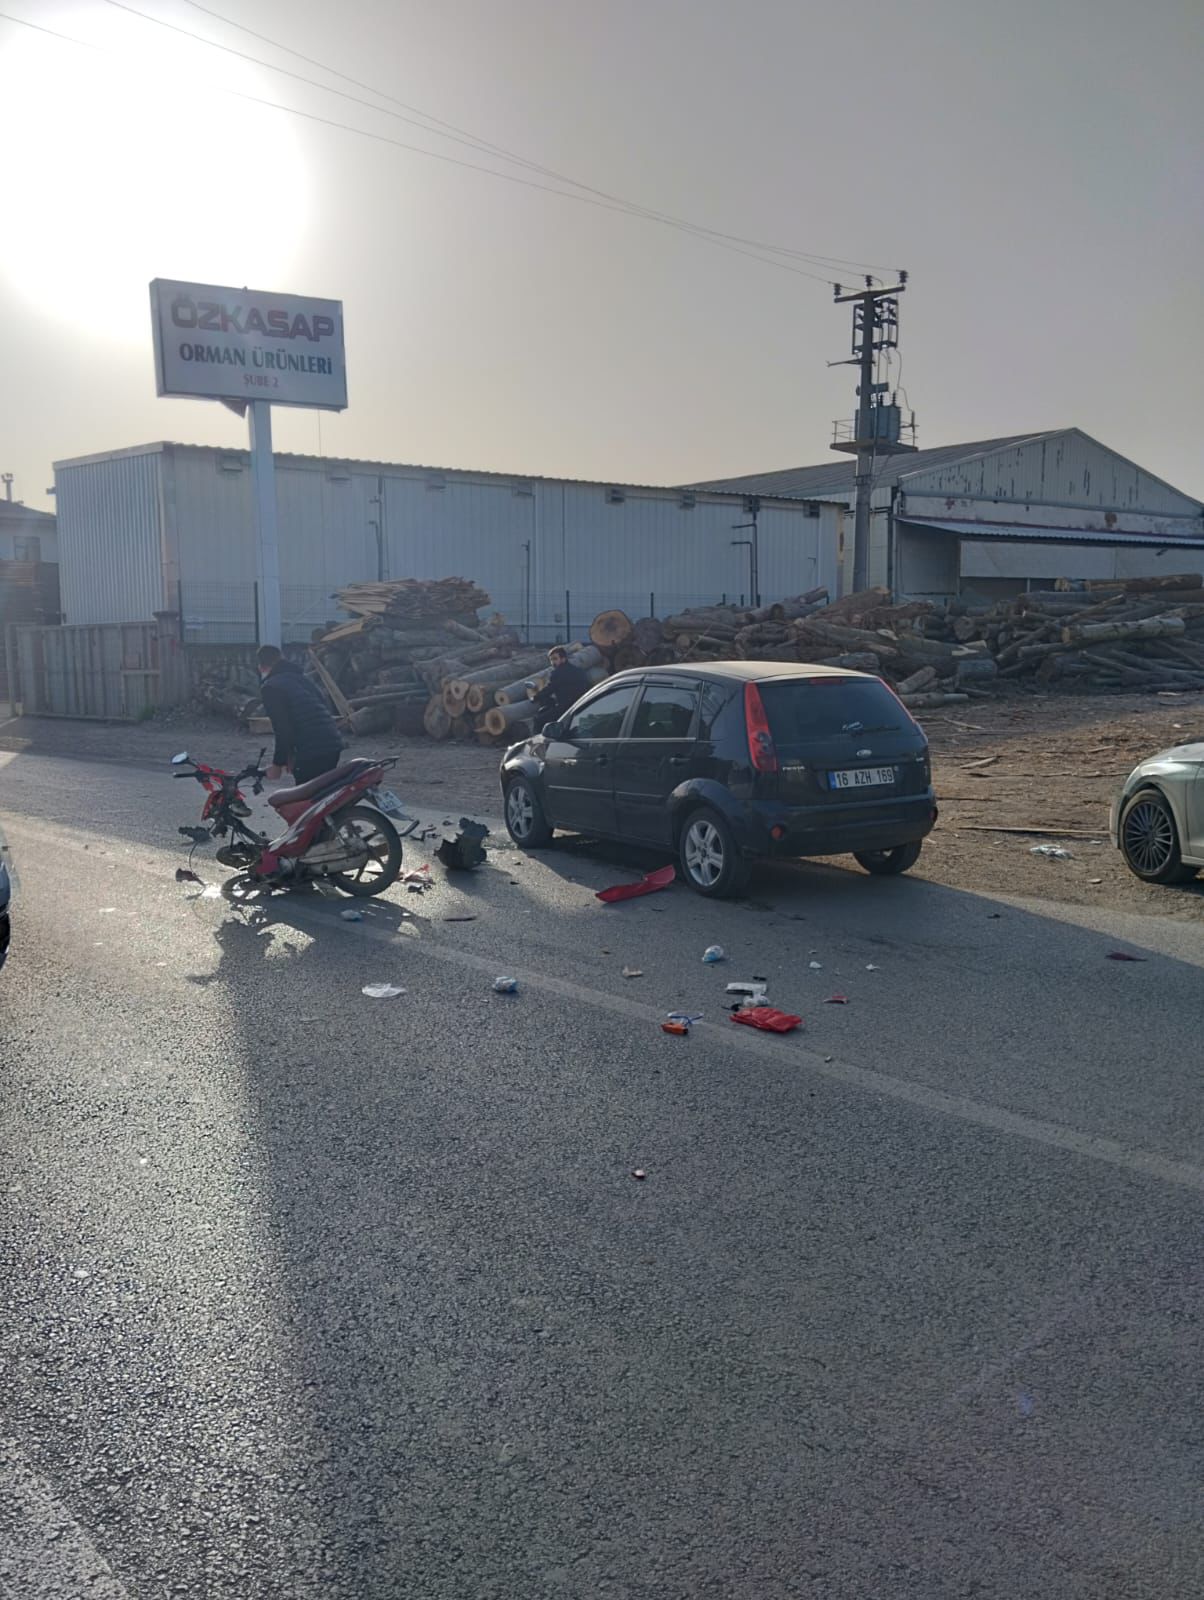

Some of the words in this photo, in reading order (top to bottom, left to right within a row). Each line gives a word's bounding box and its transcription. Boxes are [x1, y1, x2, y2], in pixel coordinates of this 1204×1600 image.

[171, 294, 335, 342] ÖZKASAP
[179, 343, 246, 367] ORMAN
[252, 347, 333, 375] ÜRÜNLERİ
[837, 772, 849, 787] 16
[854, 770, 872, 785] AZH
[877, 768, 893, 784] 169
